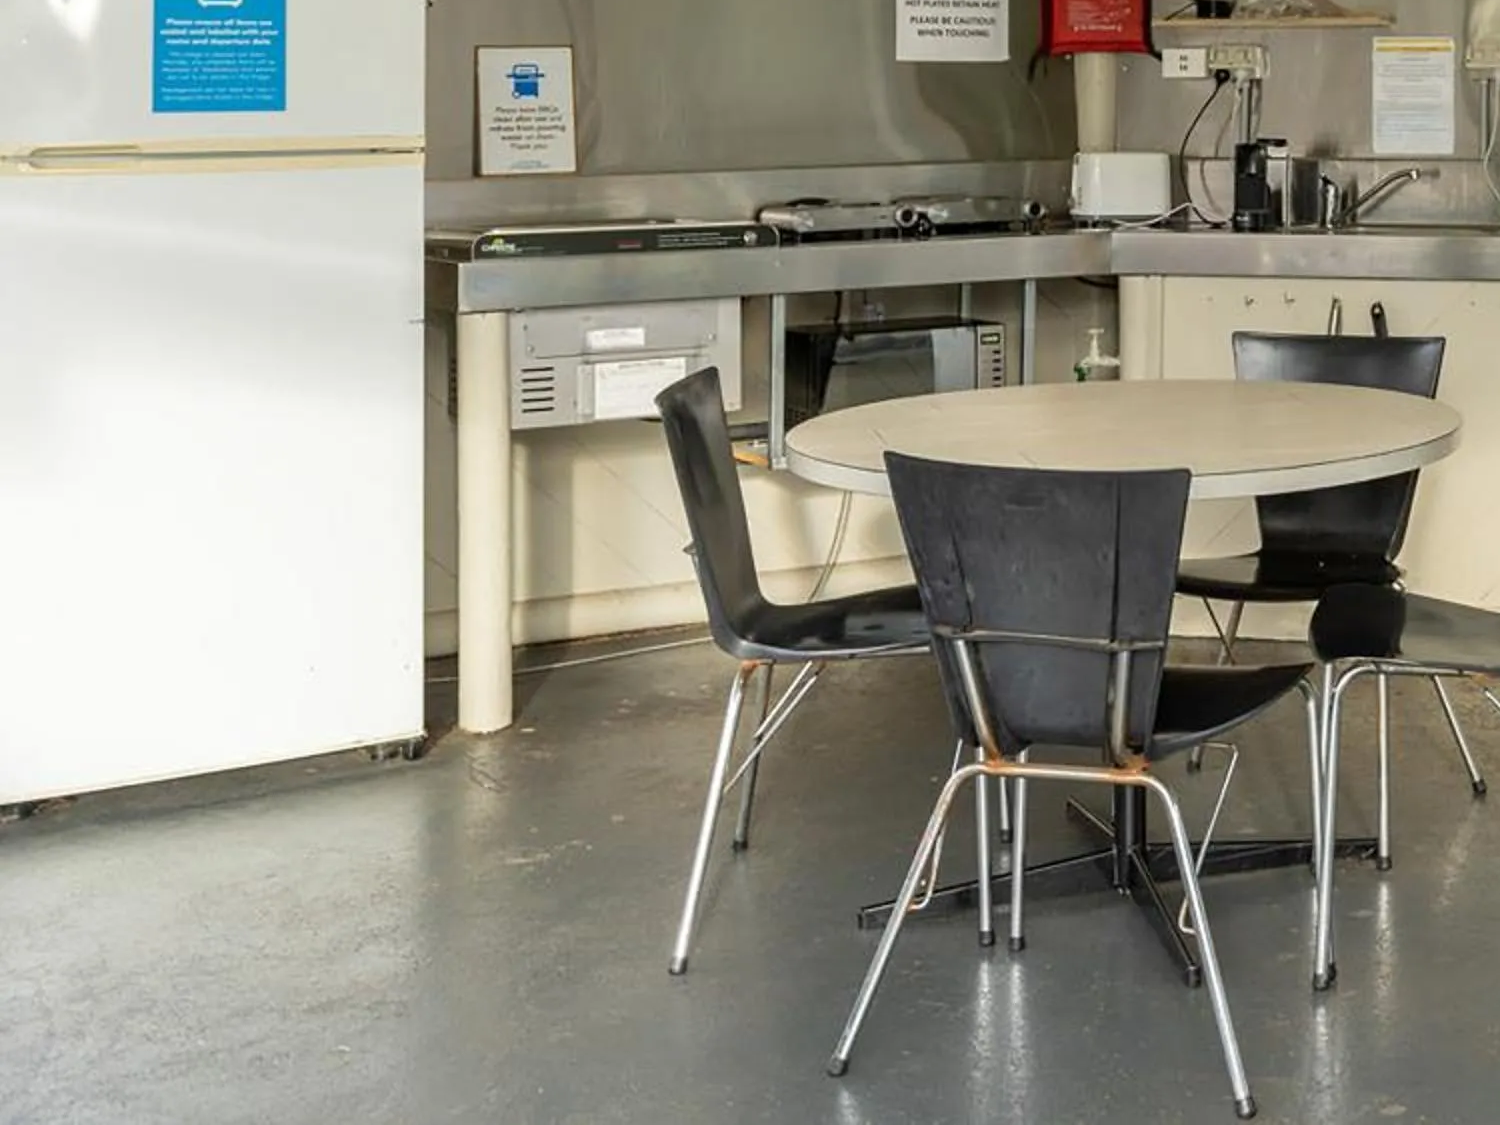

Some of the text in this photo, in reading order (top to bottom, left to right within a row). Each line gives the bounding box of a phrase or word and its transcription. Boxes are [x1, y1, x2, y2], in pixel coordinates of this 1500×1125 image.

[905, 0, 921, 8] HOT
[922, 0, 951, 8] PLATES
[909, 16, 996, 26] PLEASE BE CAUTIOUS
[917, 28, 944, 37] WHEN
